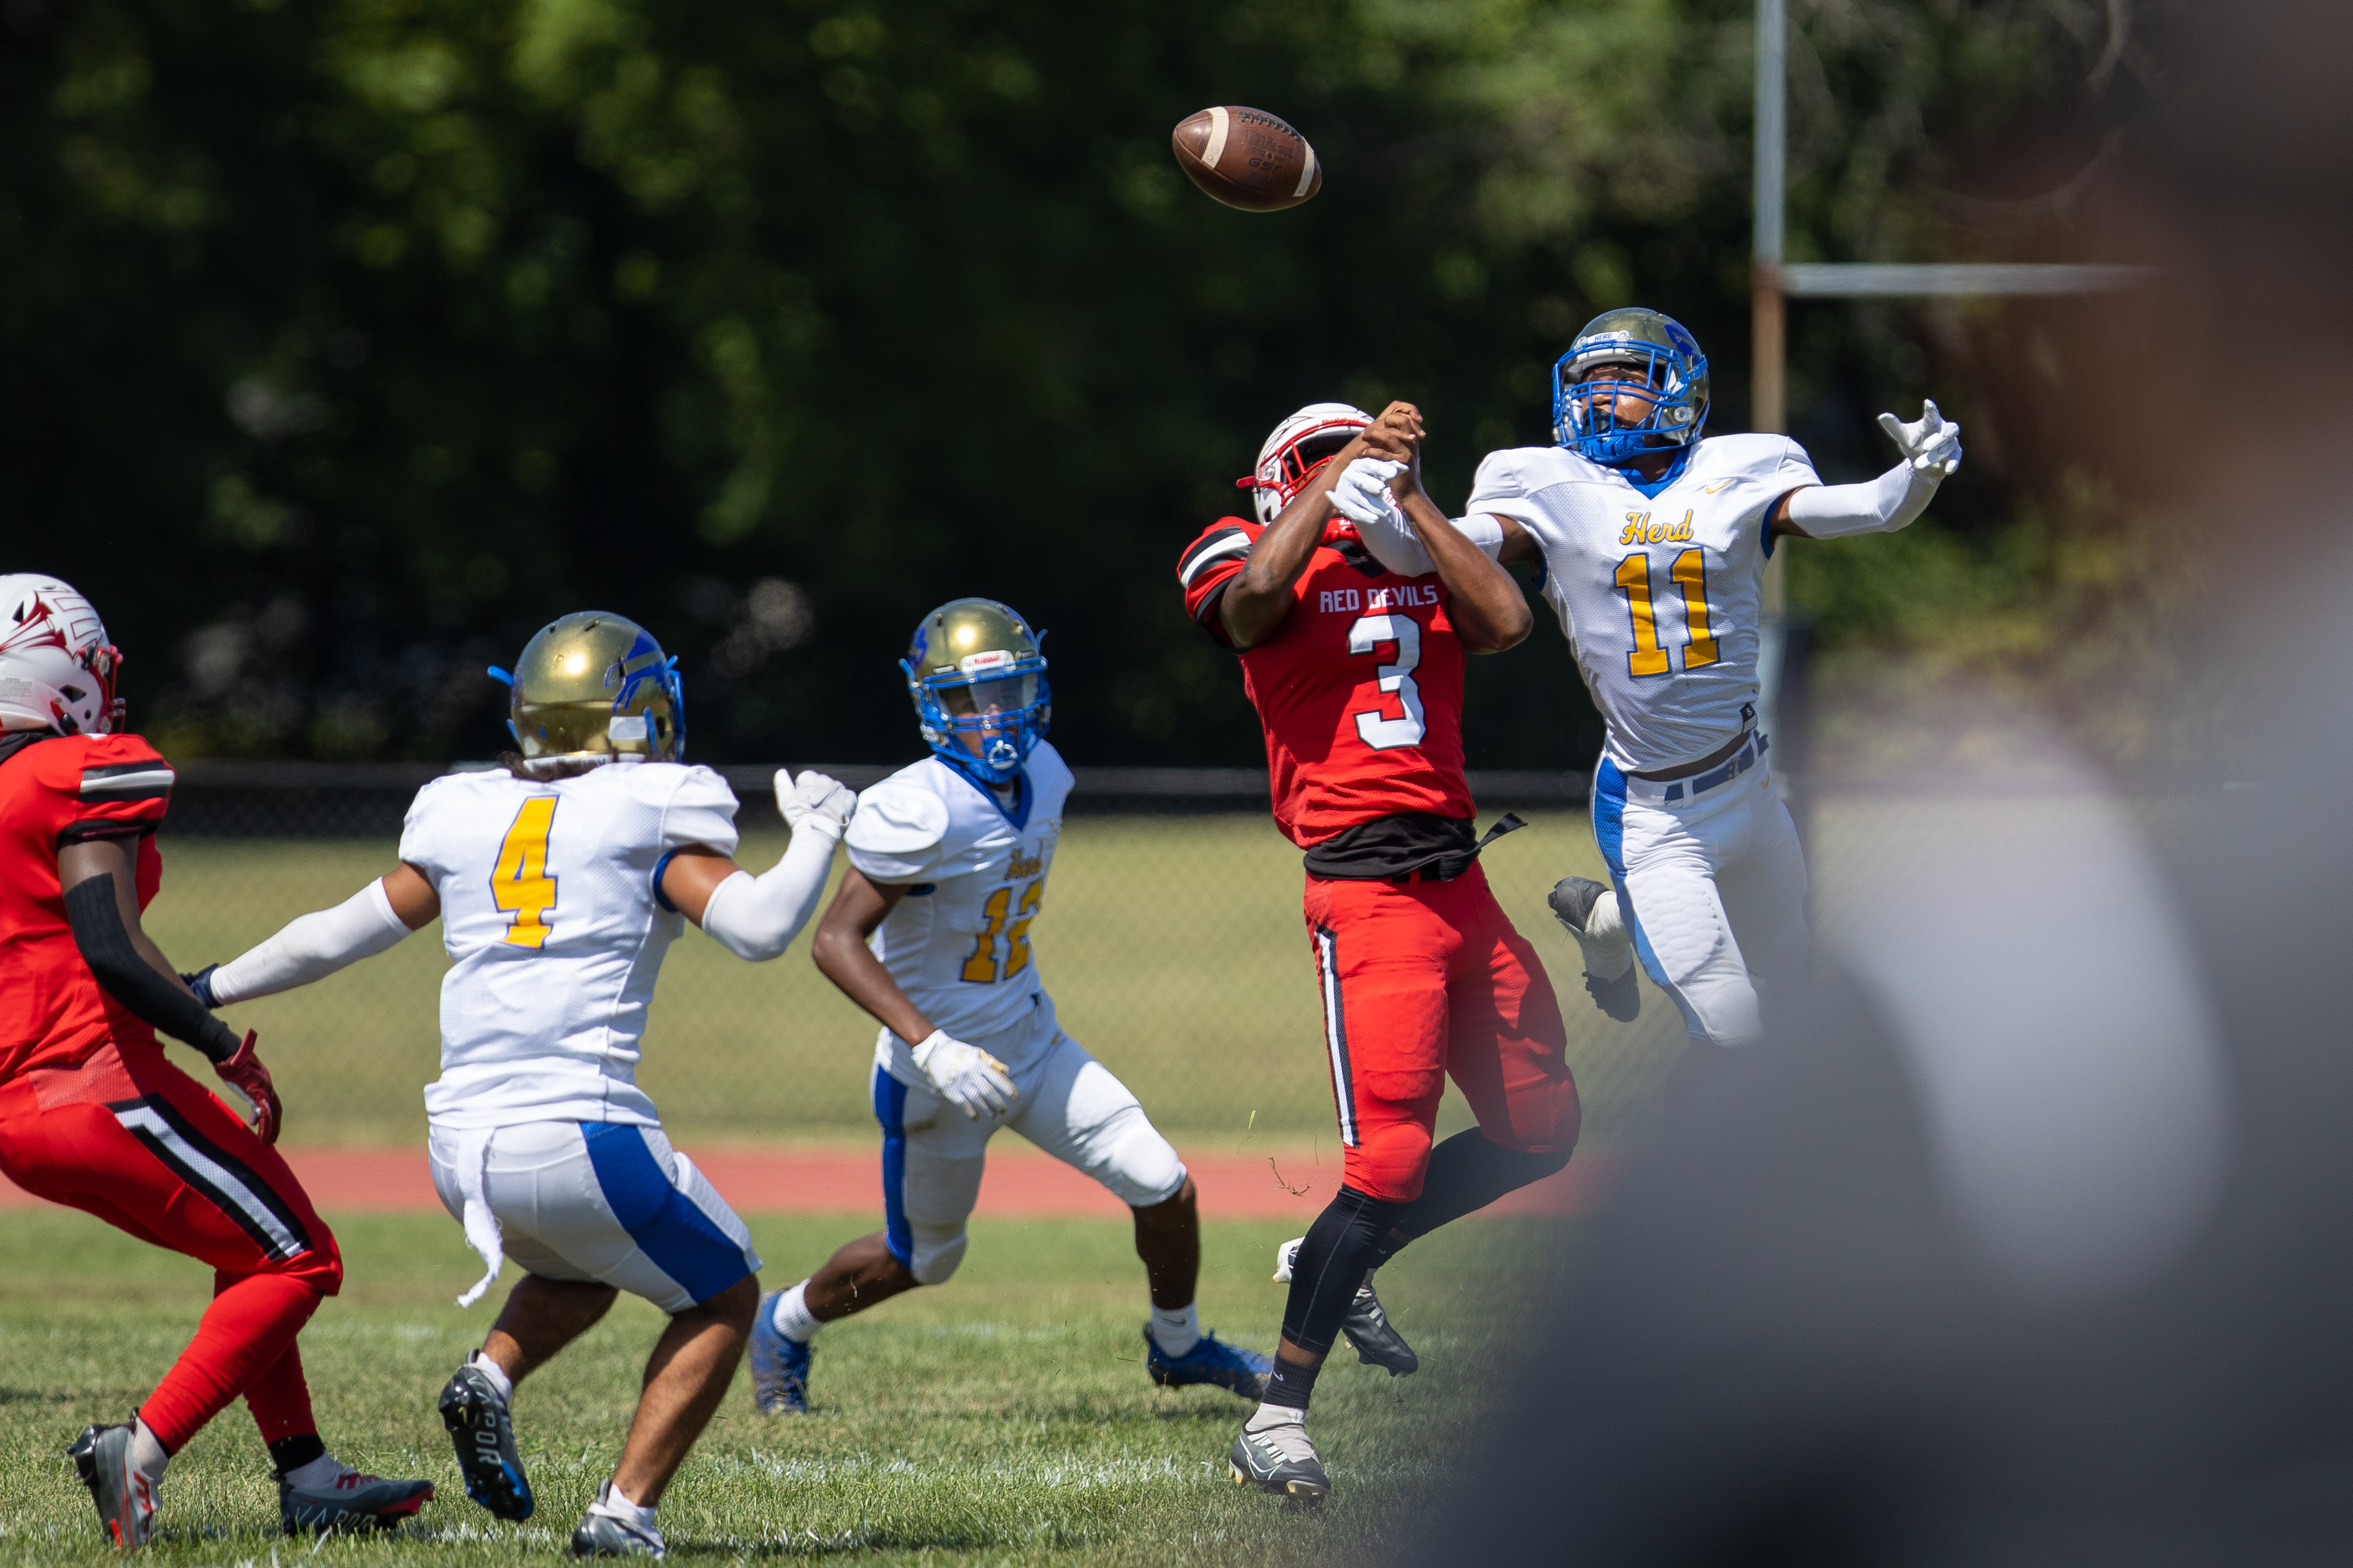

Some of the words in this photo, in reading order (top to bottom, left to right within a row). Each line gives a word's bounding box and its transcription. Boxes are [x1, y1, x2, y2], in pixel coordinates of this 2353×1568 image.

[1248, 157, 1283, 174] GST
[1594, 333, 1613, 342] HERD
[1619, 509, 1694, 545] Herd
[1320, 589, 1360, 613] RED
[1366, 585, 1439, 610] DEVILS
[1613, 546, 1721, 679] 11
[1346, 611, 1428, 752] 3
[1746, 708, 1753, 716] S
[489, 794, 561, 950] 4
[959, 878, 1042, 983] 12
[467, 1375, 502, 1466] VAPOR
